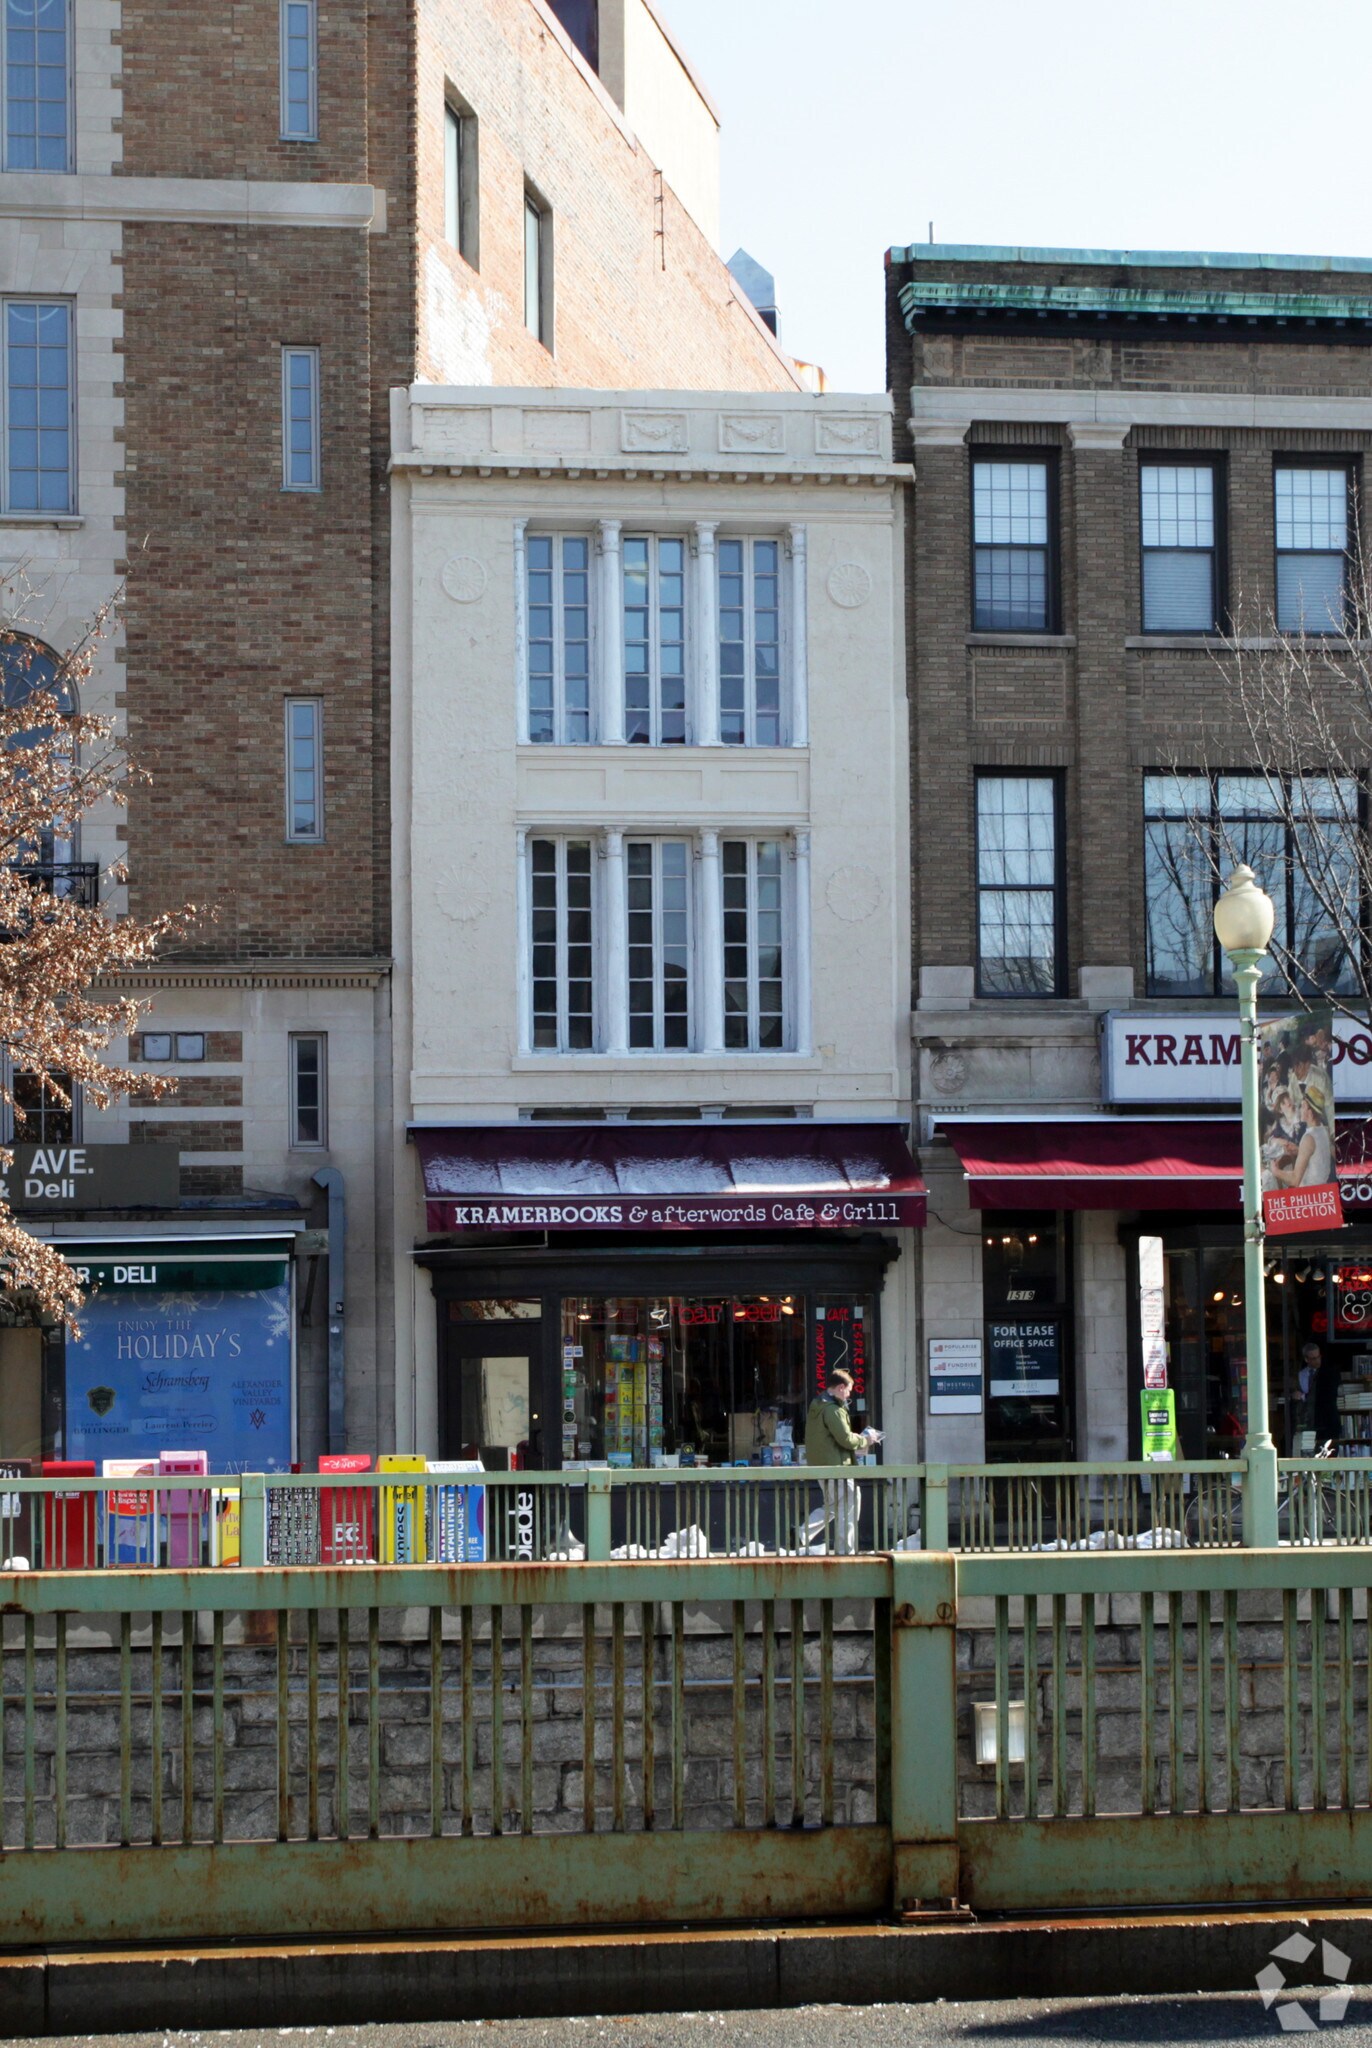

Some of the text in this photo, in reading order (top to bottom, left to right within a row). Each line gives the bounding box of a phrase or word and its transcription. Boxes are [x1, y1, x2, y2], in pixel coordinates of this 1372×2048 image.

[29, 1149, 94, 1174] AVE.
[25, 1179, 75, 1198] Deli
[1268, 1198, 1287, 1210] THE
[1290, 1191, 1335, 1206] PHILLIPS
[455, 1203, 900, 1224] KRAMERBOOKS & afterwords Cafe & Grill
[1269, 1204, 1336, 1222] COLLECTION
[113, 1265, 157, 1283] DELI
[1009, 1291, 1034, 1300] 1519
[118, 1319, 192, 1331] ENJOY THE
[993, 1325, 1054, 1336] FOR LEASE
[117, 1328, 241, 1360] HOLIDAY'S
[993, 1339, 1055, 1348] OFFICE SPACE
[142, 1367, 212, 1393] Schramsberg
[231, 1380, 282, 1389] ALEXANDER
[233, 1396, 282, 1405] VINEYARDS
[242, 1389, 274, 1397] VALLEY
[335, 1527, 360, 1542] DC
